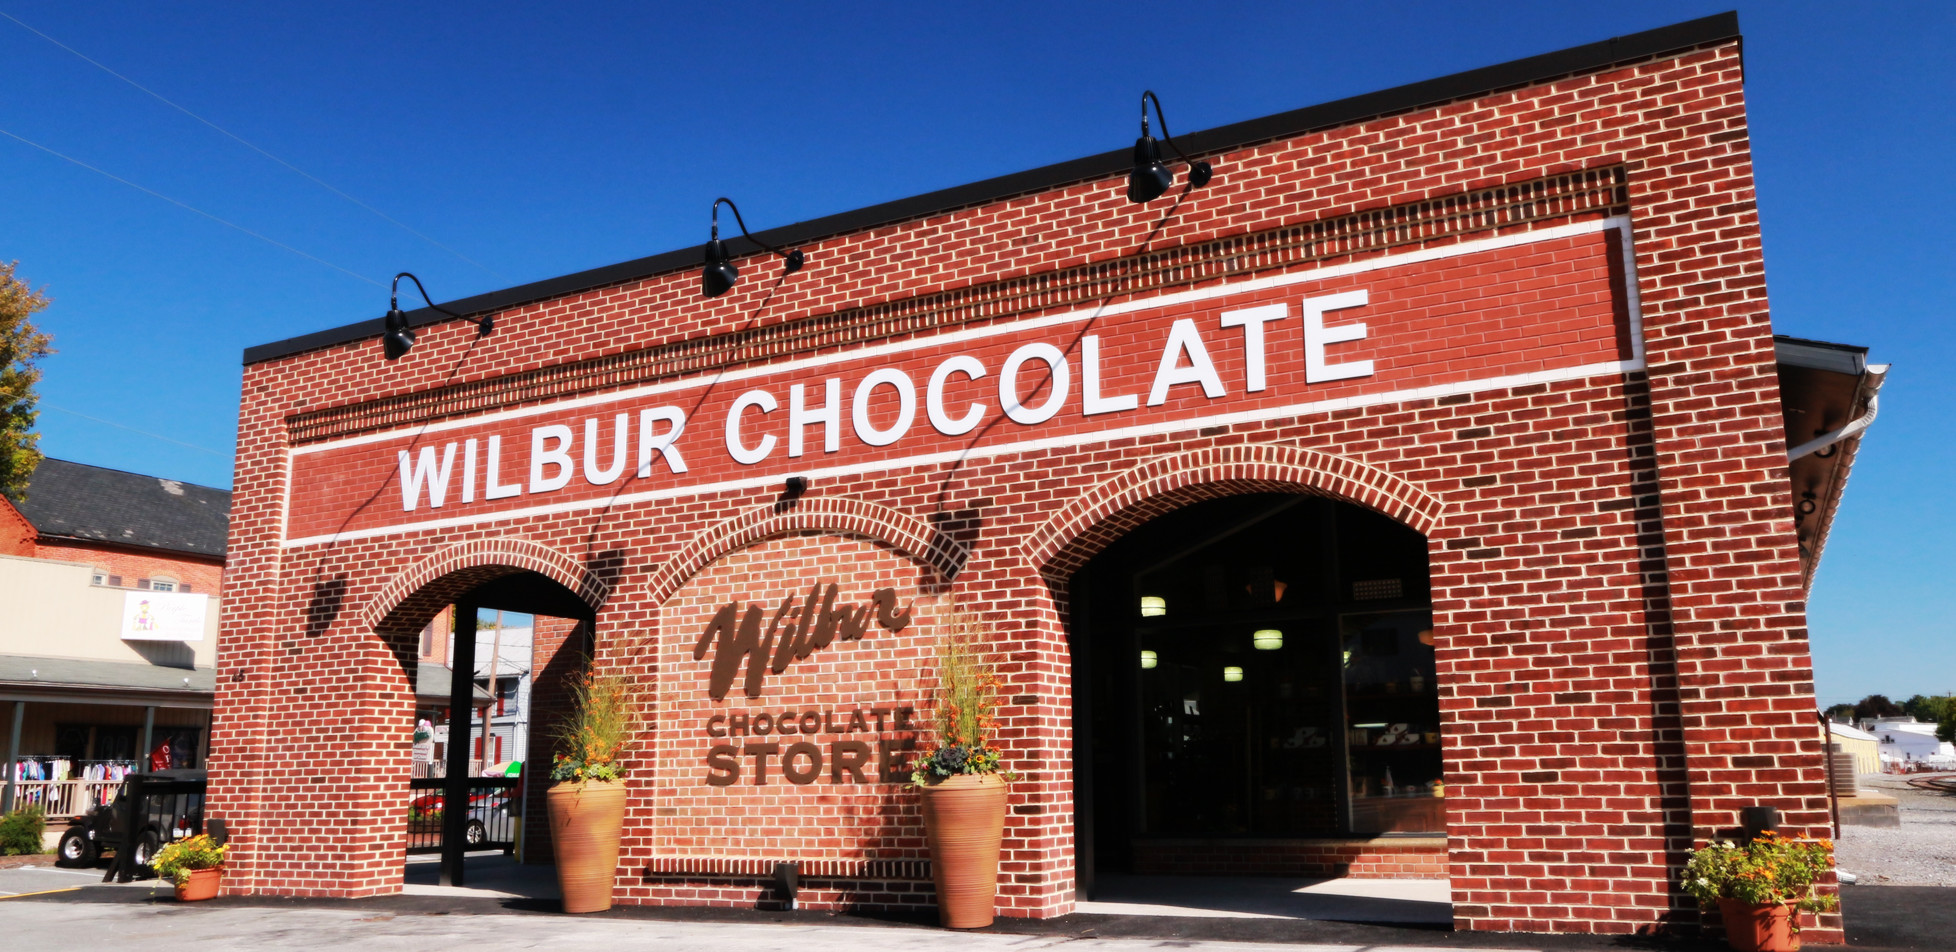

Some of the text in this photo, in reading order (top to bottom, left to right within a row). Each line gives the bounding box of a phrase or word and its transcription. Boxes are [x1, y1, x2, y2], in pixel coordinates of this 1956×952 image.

[397, 289, 1375, 512] WILBUR CHOCOLATE
[693, 582, 914, 702] Wilbur
[705, 739, 916, 787] STORE
[706, 706, 914, 737] CHOCOLATE
